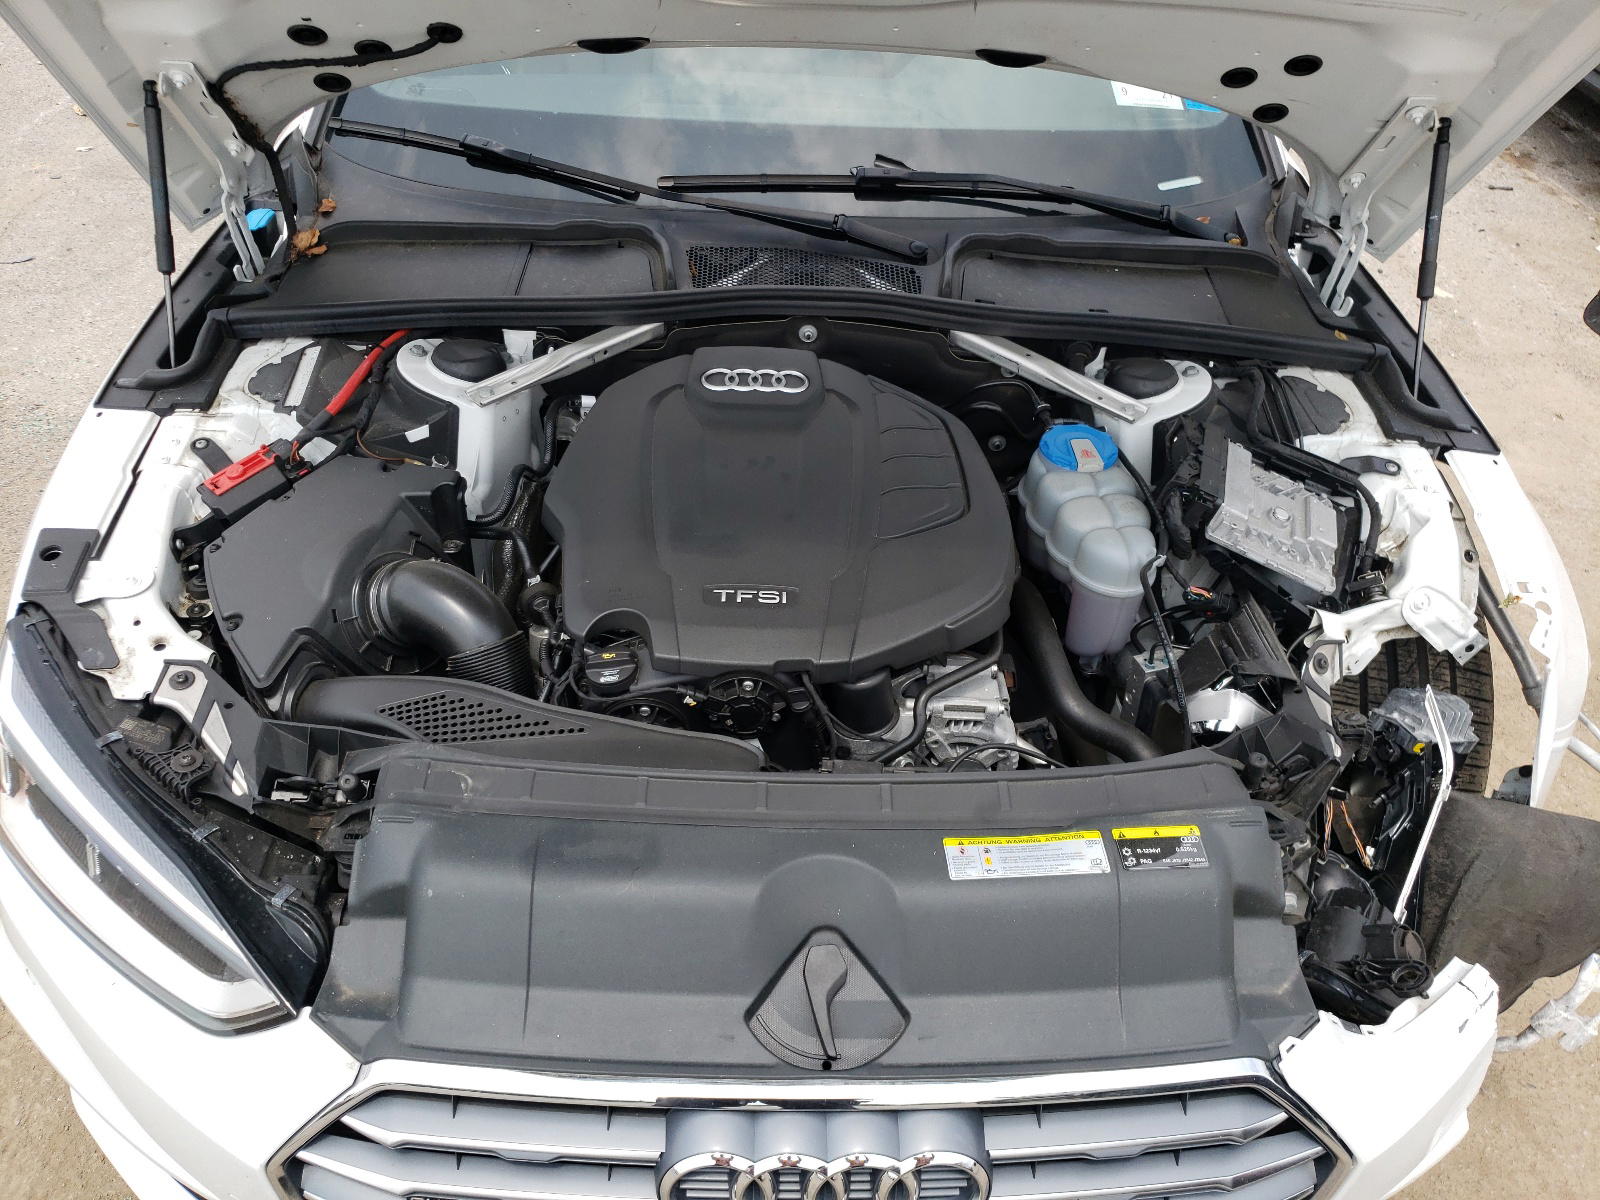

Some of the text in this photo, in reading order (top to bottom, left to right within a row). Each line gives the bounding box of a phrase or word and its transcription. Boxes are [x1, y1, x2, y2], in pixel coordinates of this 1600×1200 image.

[712, 589, 787, 604] TFSI
[1005, 837, 1042, 845] WARNING
[1044, 833, 1086, 843] ATTENTION
